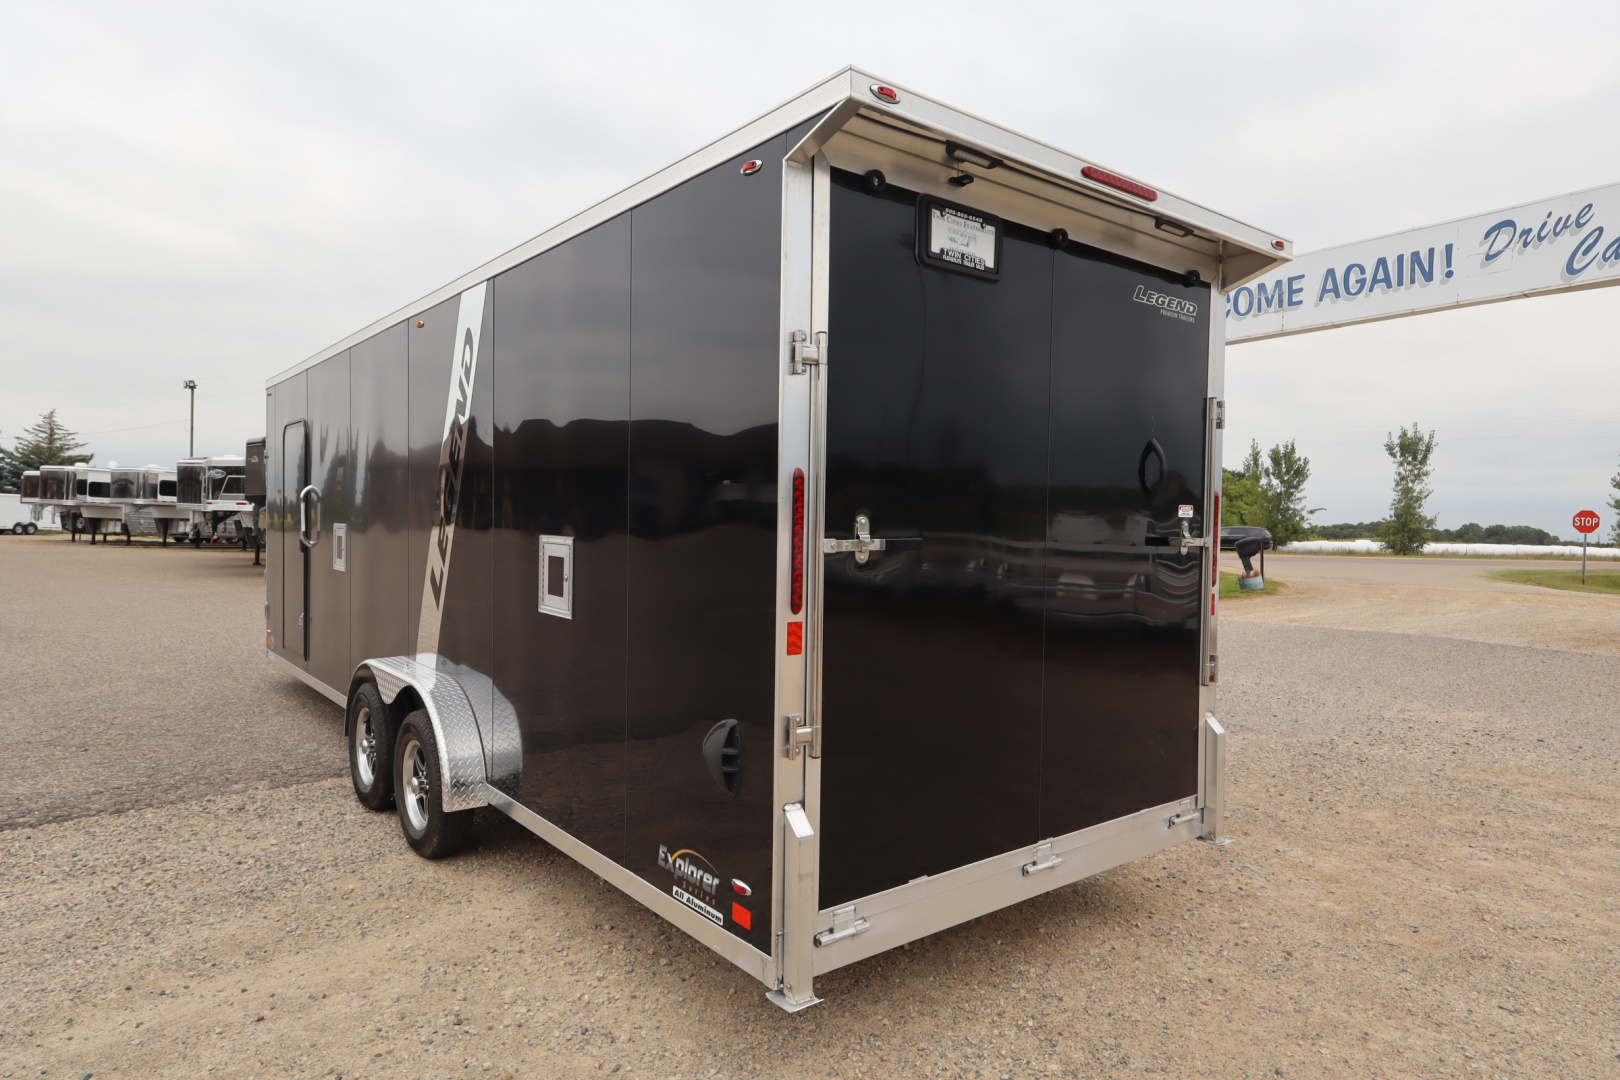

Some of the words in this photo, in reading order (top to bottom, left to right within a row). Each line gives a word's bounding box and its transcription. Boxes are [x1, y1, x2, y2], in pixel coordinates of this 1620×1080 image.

[1484, 203, 1595, 262] Drive
[944, 248, 962, 258] TWIN
[964, 254, 985, 264] CITIES
[1318, 243, 1454, 302] AGAIN!
[1133, 284, 1198, 316] LEGEND
[430, 327, 474, 611] LEGEND
[1574, 517, 1599, 527] STOP
[657, 843, 720, 895] Explorer
[674, 888, 685, 900] All
[686, 896, 722, 923] Aluminum
